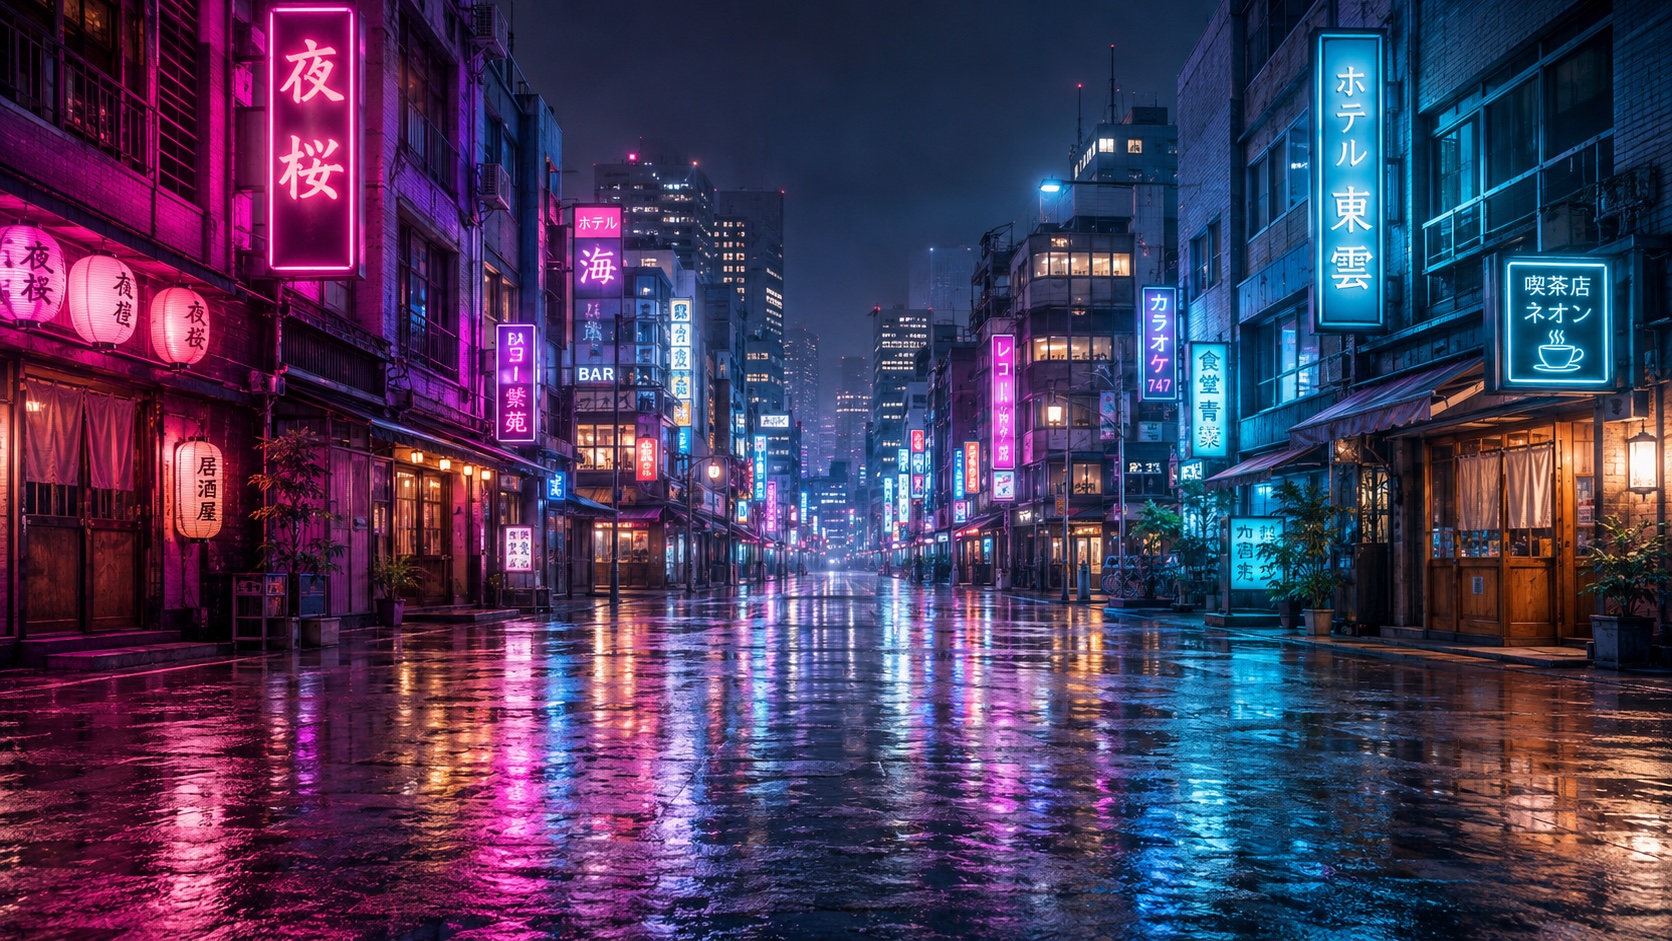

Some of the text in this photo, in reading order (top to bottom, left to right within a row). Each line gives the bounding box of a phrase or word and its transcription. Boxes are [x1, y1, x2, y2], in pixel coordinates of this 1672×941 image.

[279, 38, 345, 201] 夜桜
[578, 215, 618, 231] ホテル
[20, 241, 55, 306] 夜桜
[580, 246, 617, 285] 海
[1524, 275, 1591, 297] 喫茶店
[1524, 301, 1592, 324] ネオン
[1150, 294, 1170, 373] カラオケ
[578, 366, 614, 382] BAR
[1147, 379, 1171, 393] 747
[196, 456, 218, 522] 居酒屋
